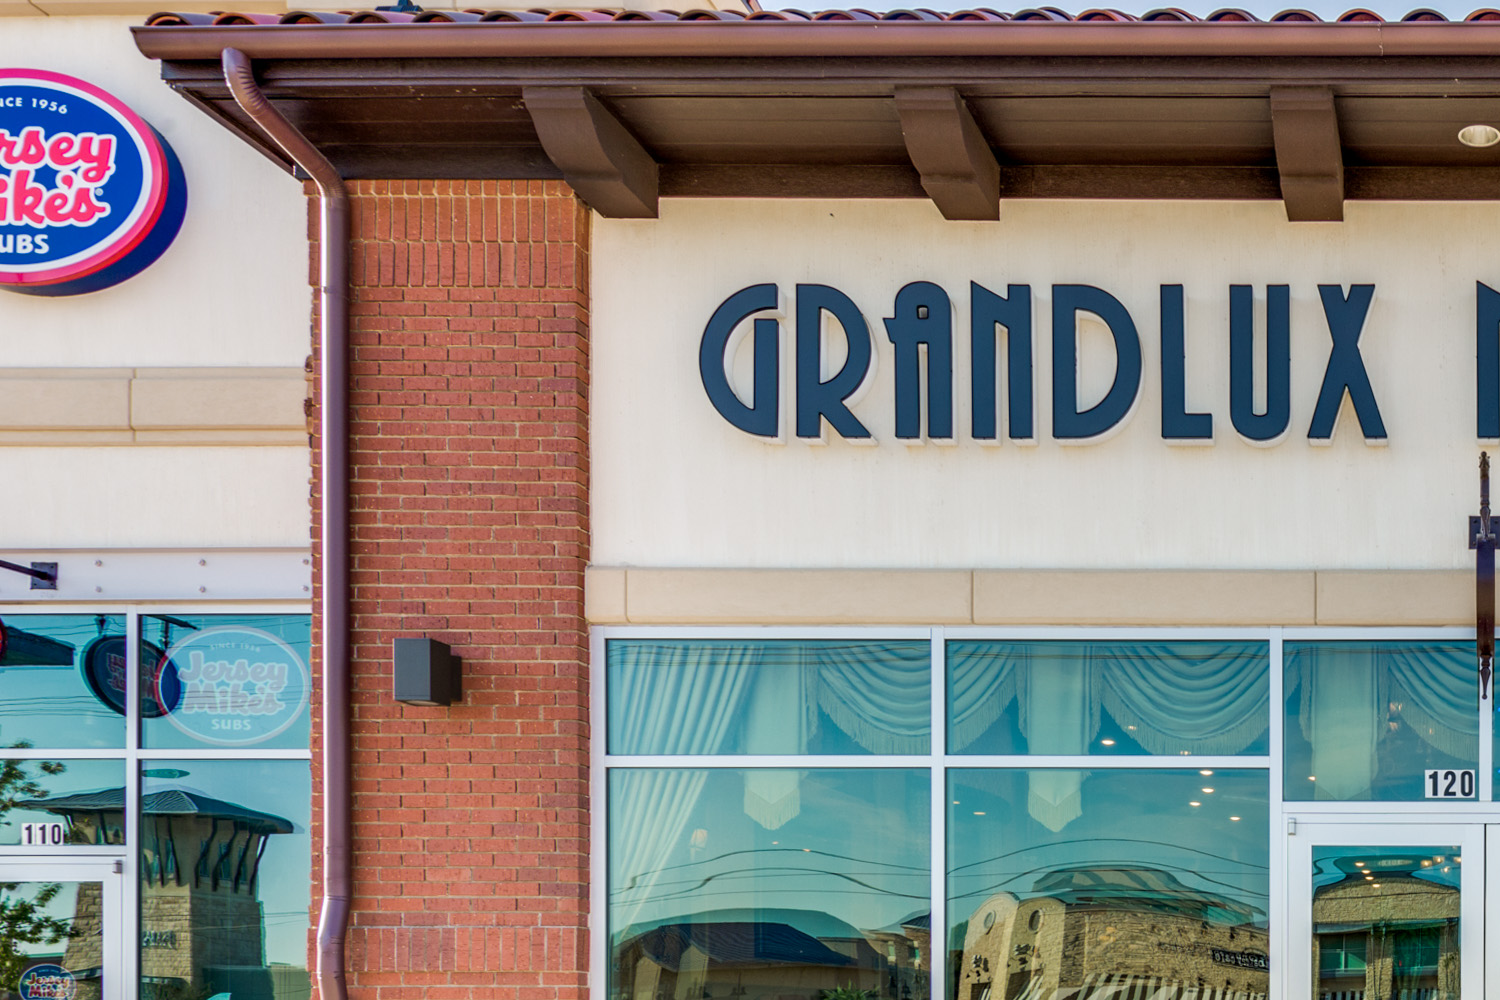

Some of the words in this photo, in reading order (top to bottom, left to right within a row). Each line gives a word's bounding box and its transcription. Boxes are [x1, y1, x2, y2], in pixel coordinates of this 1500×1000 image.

[31, 98, 68, 115] 1956
[699, 280, 1390, 442] GRANDLUX
[179, 651, 288, 693] Jersey
[182, 682, 286, 716] Mike's
[211, 719, 252, 731] SUBS
[1428, 770, 1474, 797] 120
[24, 824, 62, 845] 110
[26, 972, 70, 989] Jersey
